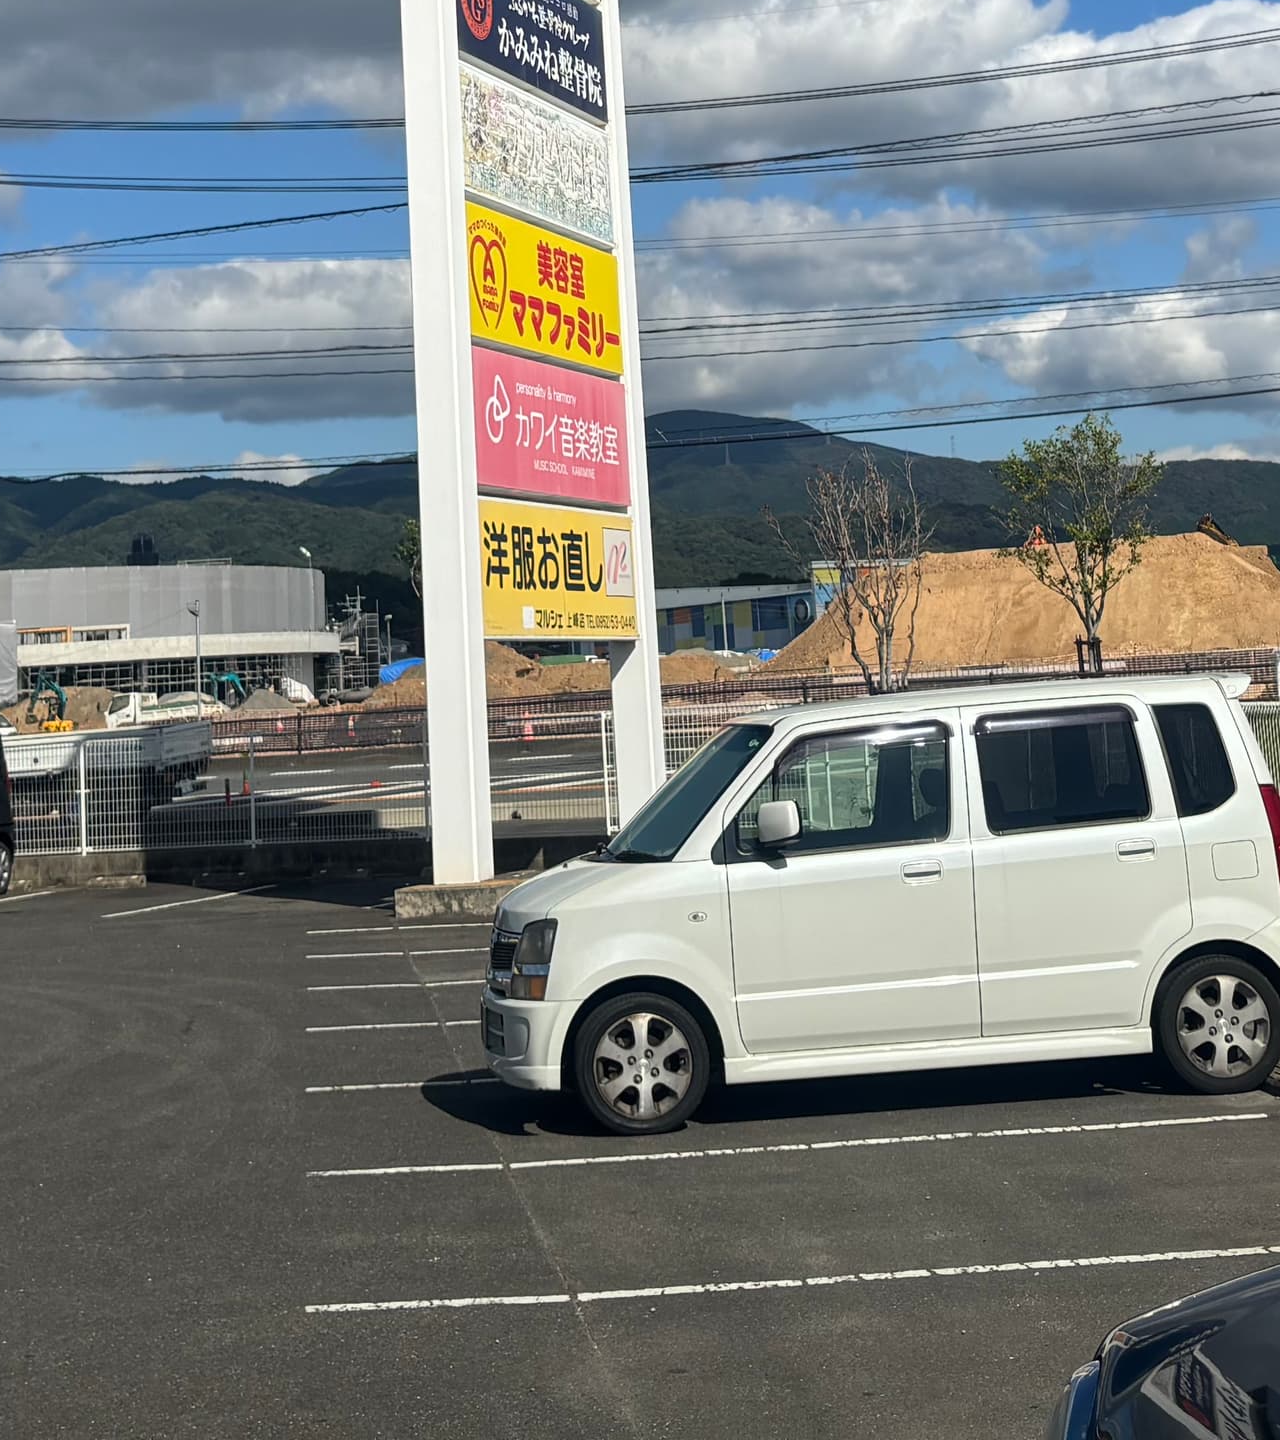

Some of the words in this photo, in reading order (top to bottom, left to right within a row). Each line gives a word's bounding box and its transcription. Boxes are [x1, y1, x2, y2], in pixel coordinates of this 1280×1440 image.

[497, 17, 603, 108] かみみね整骨院
[536, 239, 586, 301] 美容室
[509, 289, 621, 359] ママファミリー
[514, 405, 620, 466] カワイ音楽教室
[483, 520, 603, 593] 洋服お直し
[535, 609, 563, 629] マルシェ
